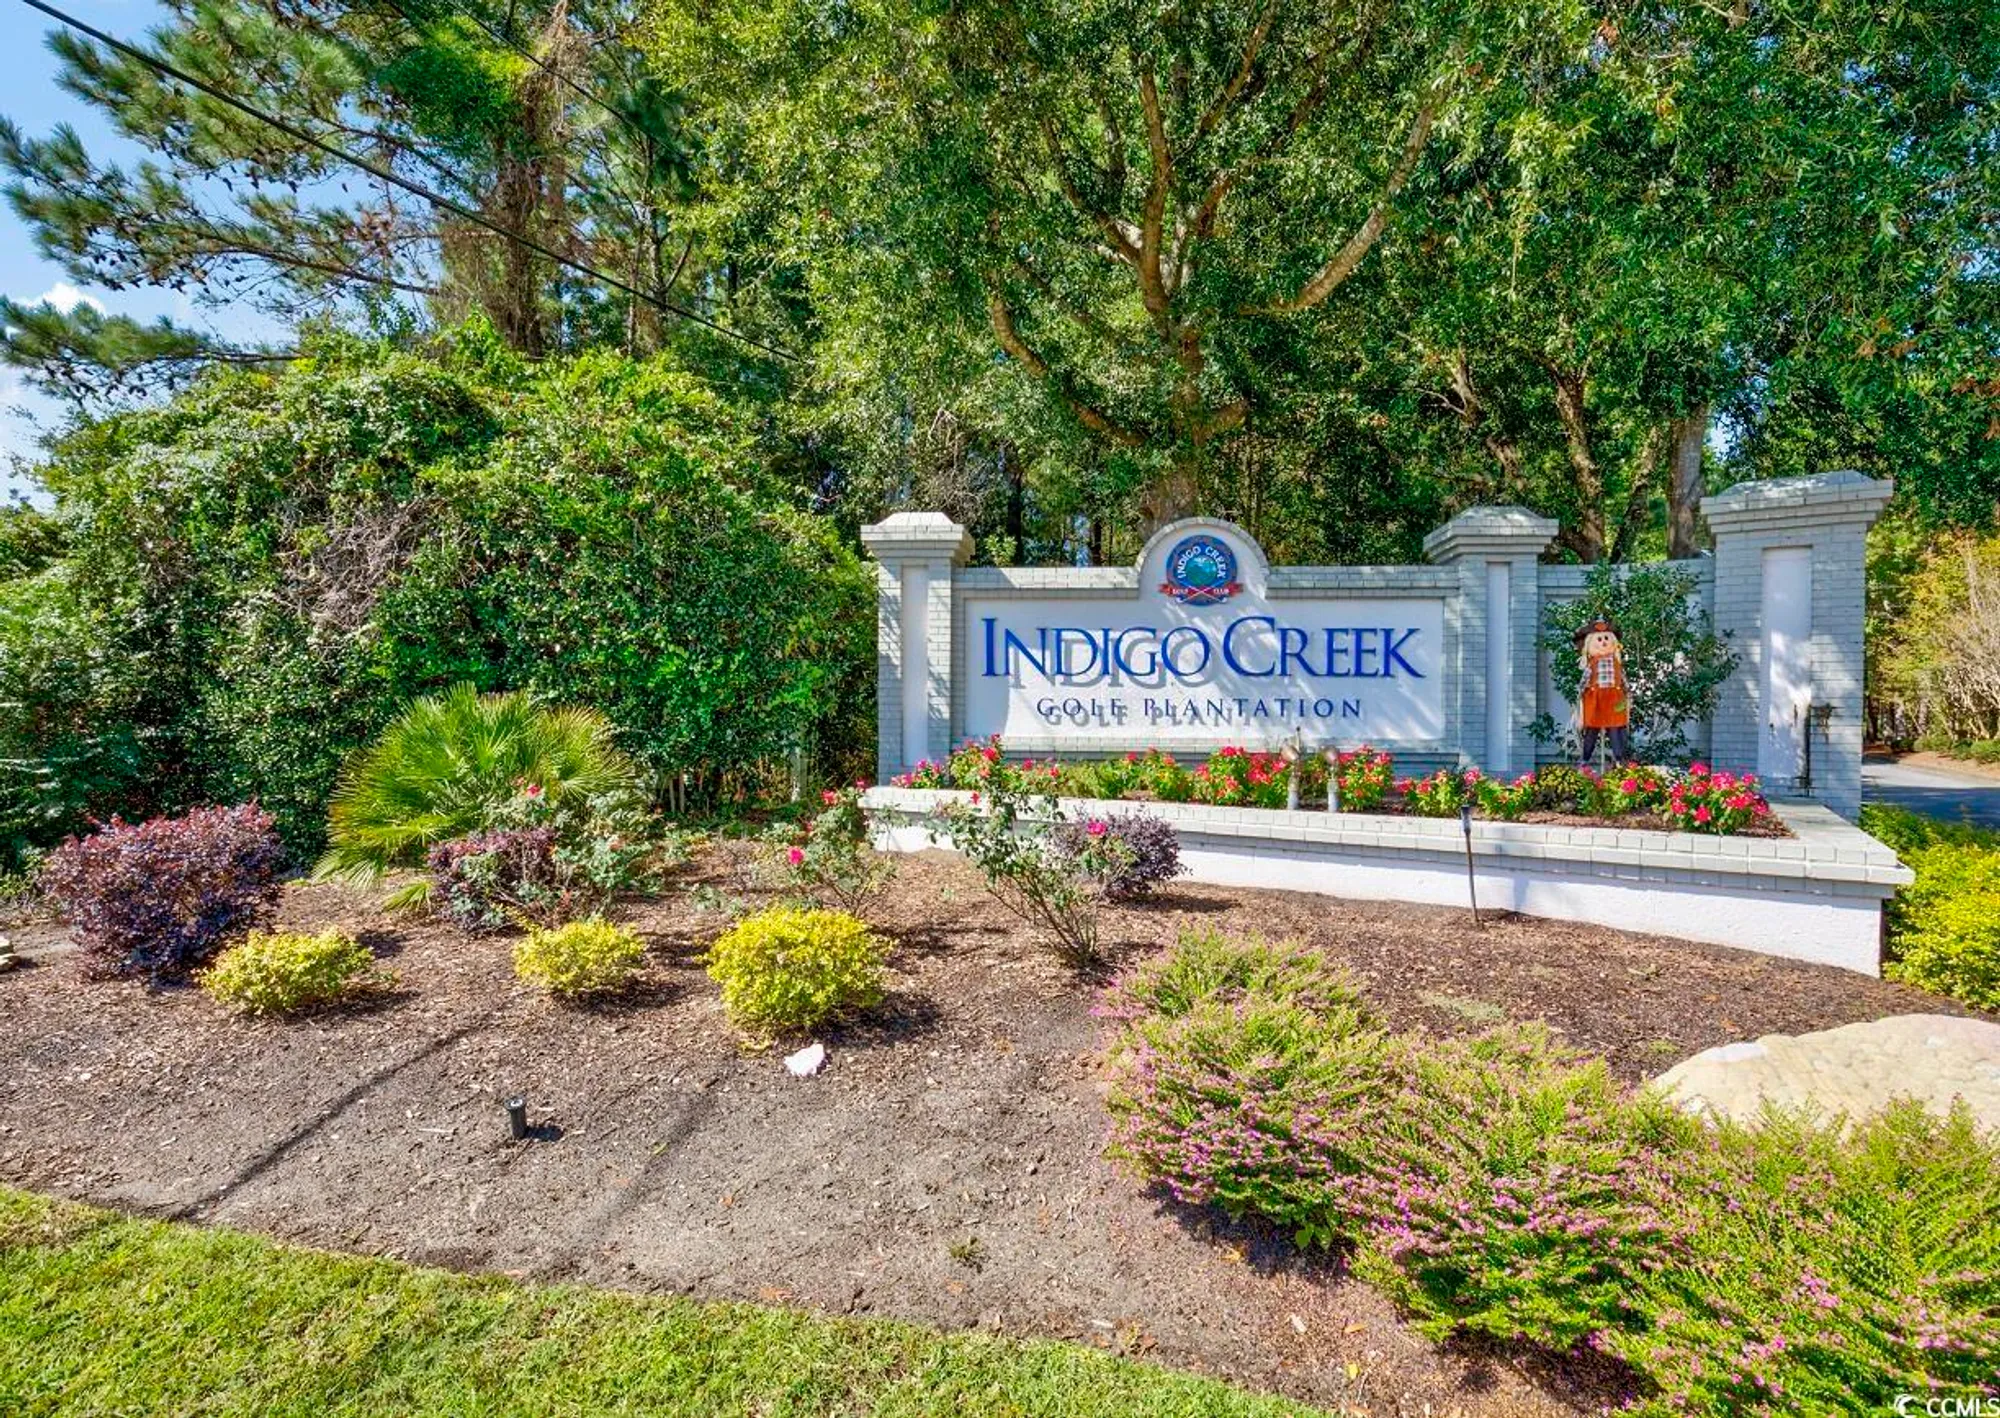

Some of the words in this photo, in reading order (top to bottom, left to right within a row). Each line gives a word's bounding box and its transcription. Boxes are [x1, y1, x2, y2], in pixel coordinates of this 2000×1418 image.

[1178, 546, 1202, 579] INDIGO
[1204, 546, 1226, 579] CREEK
[981, 617, 1211, 678] INDIGO
[1222, 615, 1427, 679] CREEK
[1036, 697, 1122, 717] GOLF
[1143, 698, 1361, 718] PLANTATION
